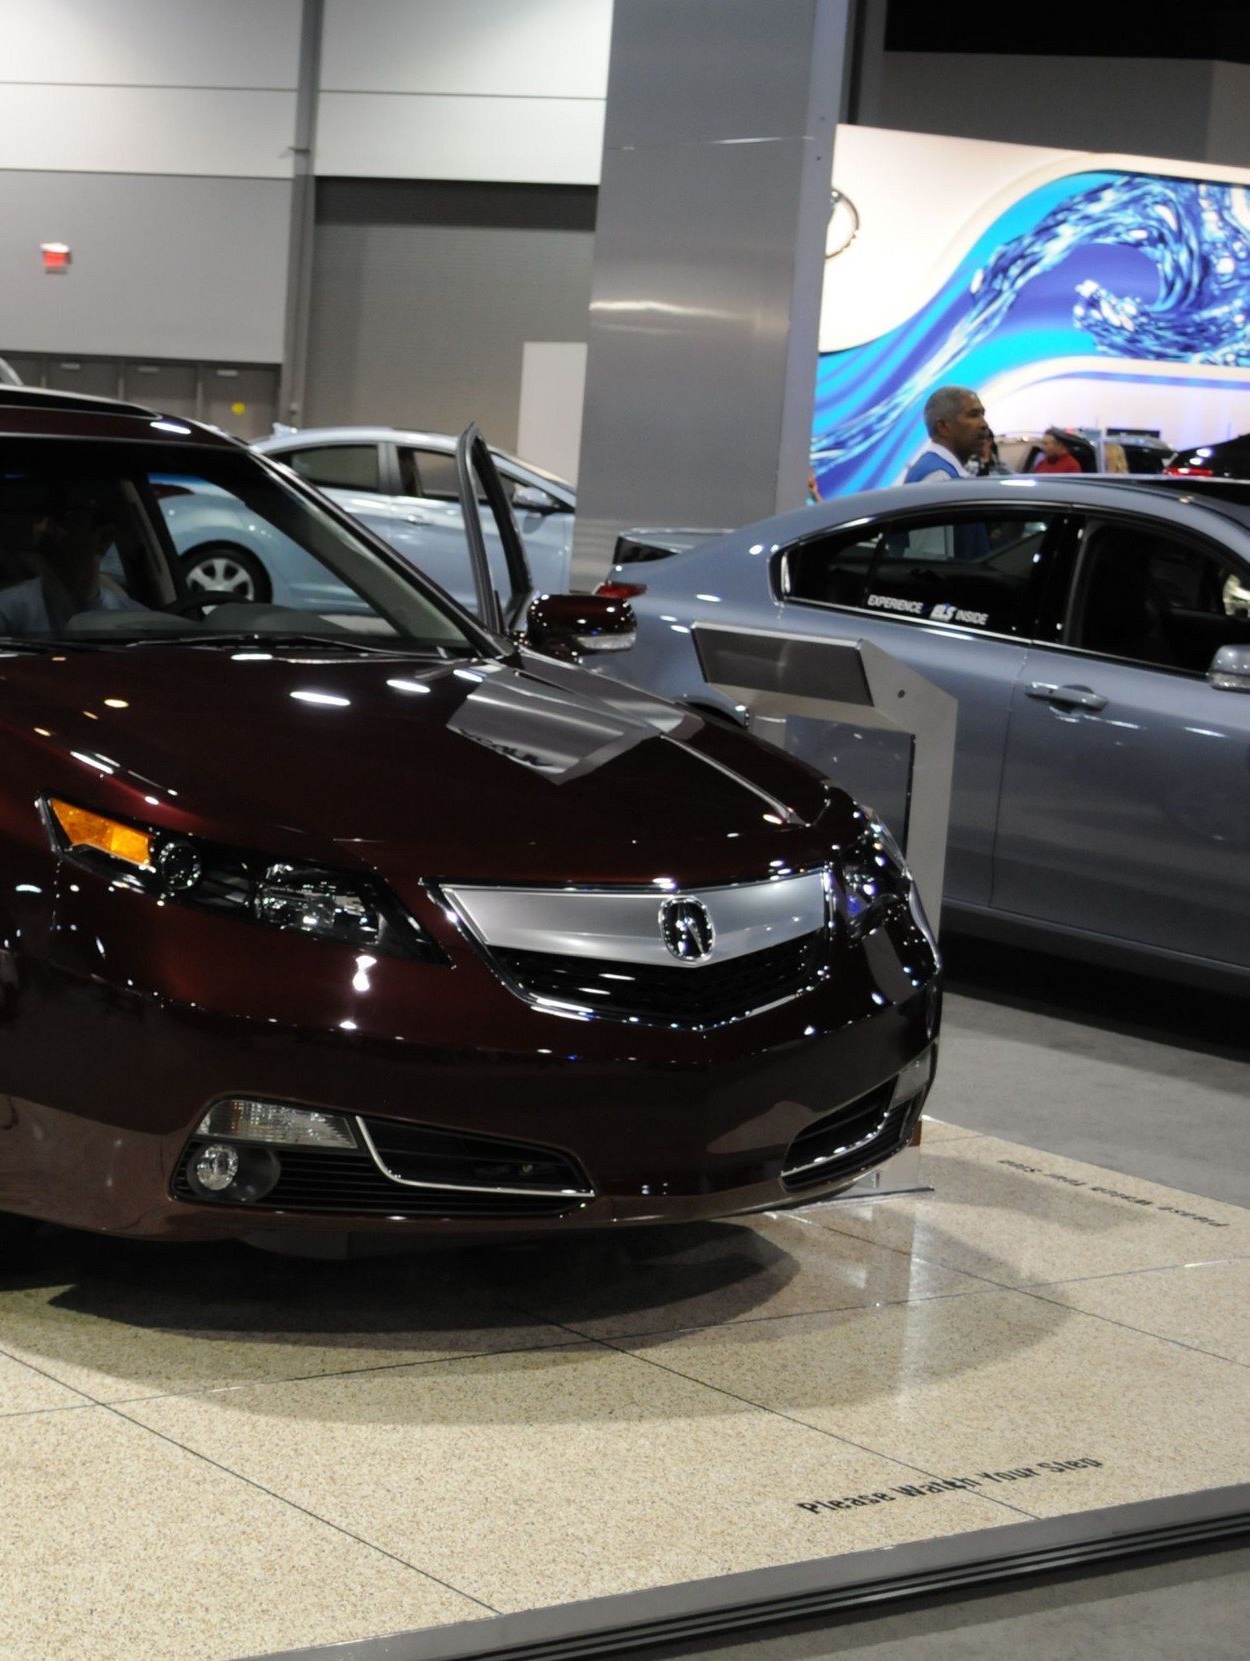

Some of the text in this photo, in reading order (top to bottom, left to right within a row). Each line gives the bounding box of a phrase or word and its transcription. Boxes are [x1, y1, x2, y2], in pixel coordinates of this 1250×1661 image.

[868, 594, 923, 614] EXPERIENCE
[955, 609, 989, 625] INSIDE
[796, 1455, 1104, 1515] Please Watch Your Step
